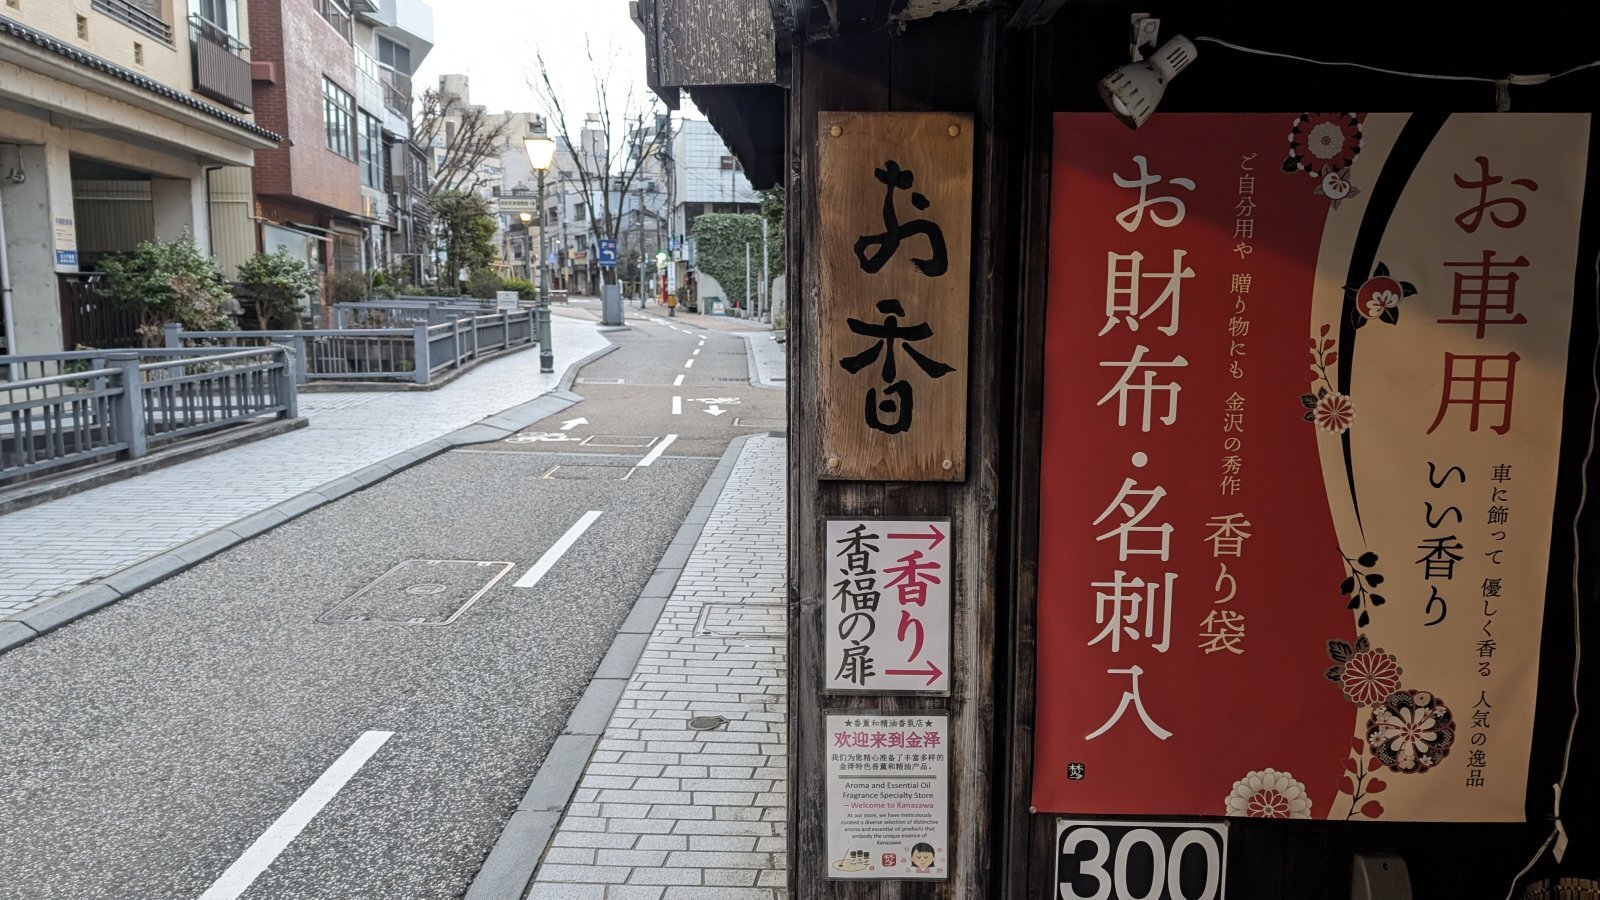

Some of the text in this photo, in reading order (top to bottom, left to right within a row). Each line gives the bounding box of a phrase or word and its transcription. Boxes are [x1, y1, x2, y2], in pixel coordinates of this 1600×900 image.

[839, 159, 957, 434] お香
[1220, 152, 1258, 496] ご自分用や 贈り物にも 金沢の秀作
[1426, 156, 1539, 436] お車用
[1084, 155, 1196, 741] お財布・名刺入
[832, 523, 881, 687] 香福の扉
[883, 549, 942, 664] 香り
[1198, 511, 1253, 655] 香り袋
[1415, 460, 1467, 628] いい香り
[1465, 463, 1512, 788] 車に飾って 優しく香る 人気の逸品
[834, 730, 941, 749] 欢迎来到金泽
[842, 792, 934, 800] Fragrance Specialty Store
[1059, 828, 1220, 900] 300
